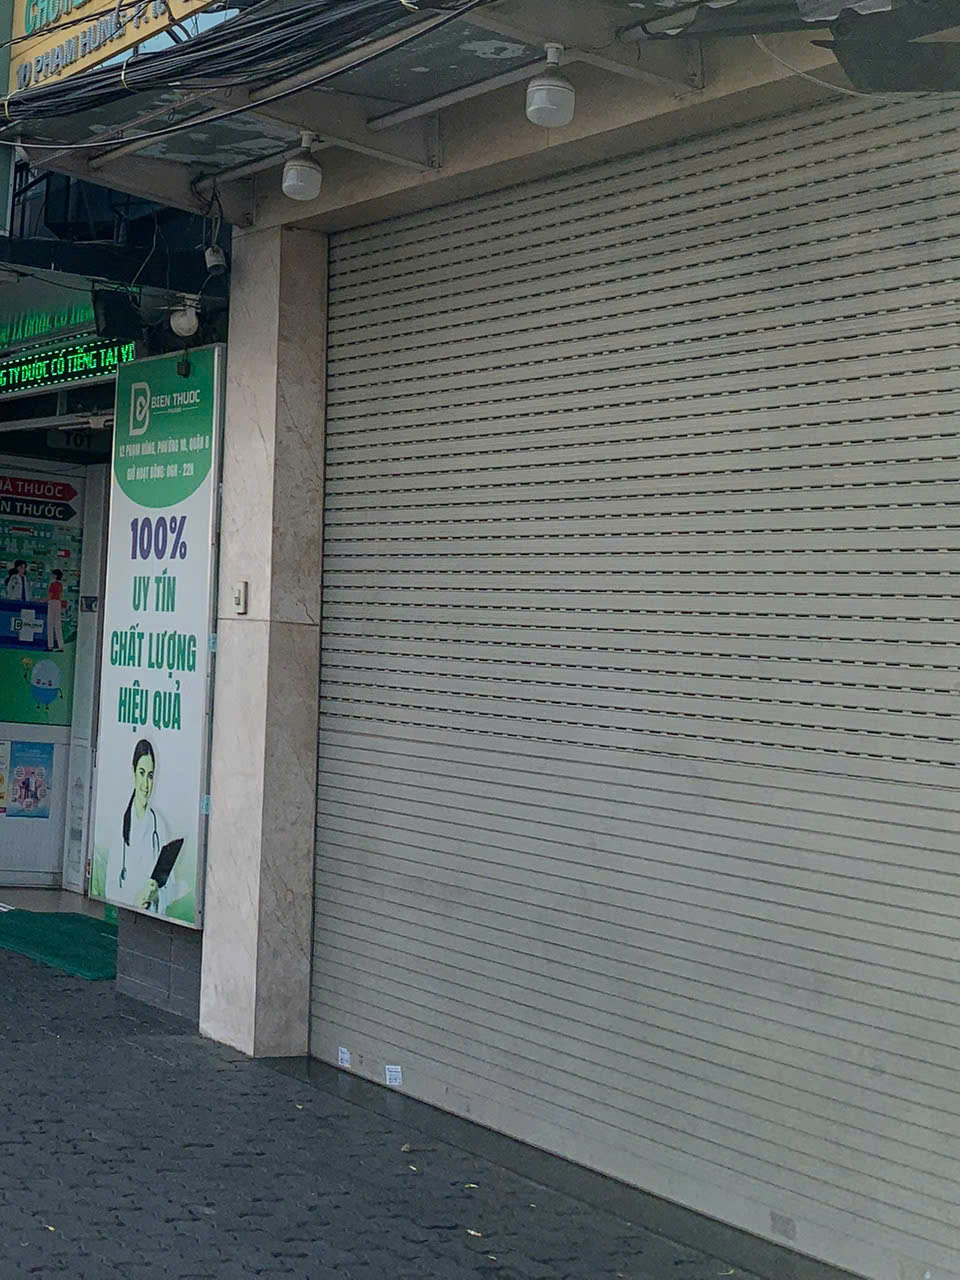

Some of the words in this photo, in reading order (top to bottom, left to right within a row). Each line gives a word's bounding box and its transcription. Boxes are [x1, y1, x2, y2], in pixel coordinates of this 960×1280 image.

[8, 367, 20, 384] TY
[22, 360, 50, 385] DƯỢC
[51, 354, 64, 374] CÓ
[68, 347, 97, 372] TIẾNG
[99, 348, 118, 371] TẠI
[151, 394, 171, 409] BIEN
[173, 390, 200, 405] THUOC
[130, 516, 187, 560] 100%
[132, 575, 150, 612] UY
[155, 568, 176, 612] TÍN
[110, 623, 145, 668] CHẤT
[148, 631, 197, 678] LƯỢNG
[118, 680, 148, 732] HIỆU
[152, 680, 182, 730] QUẢ
